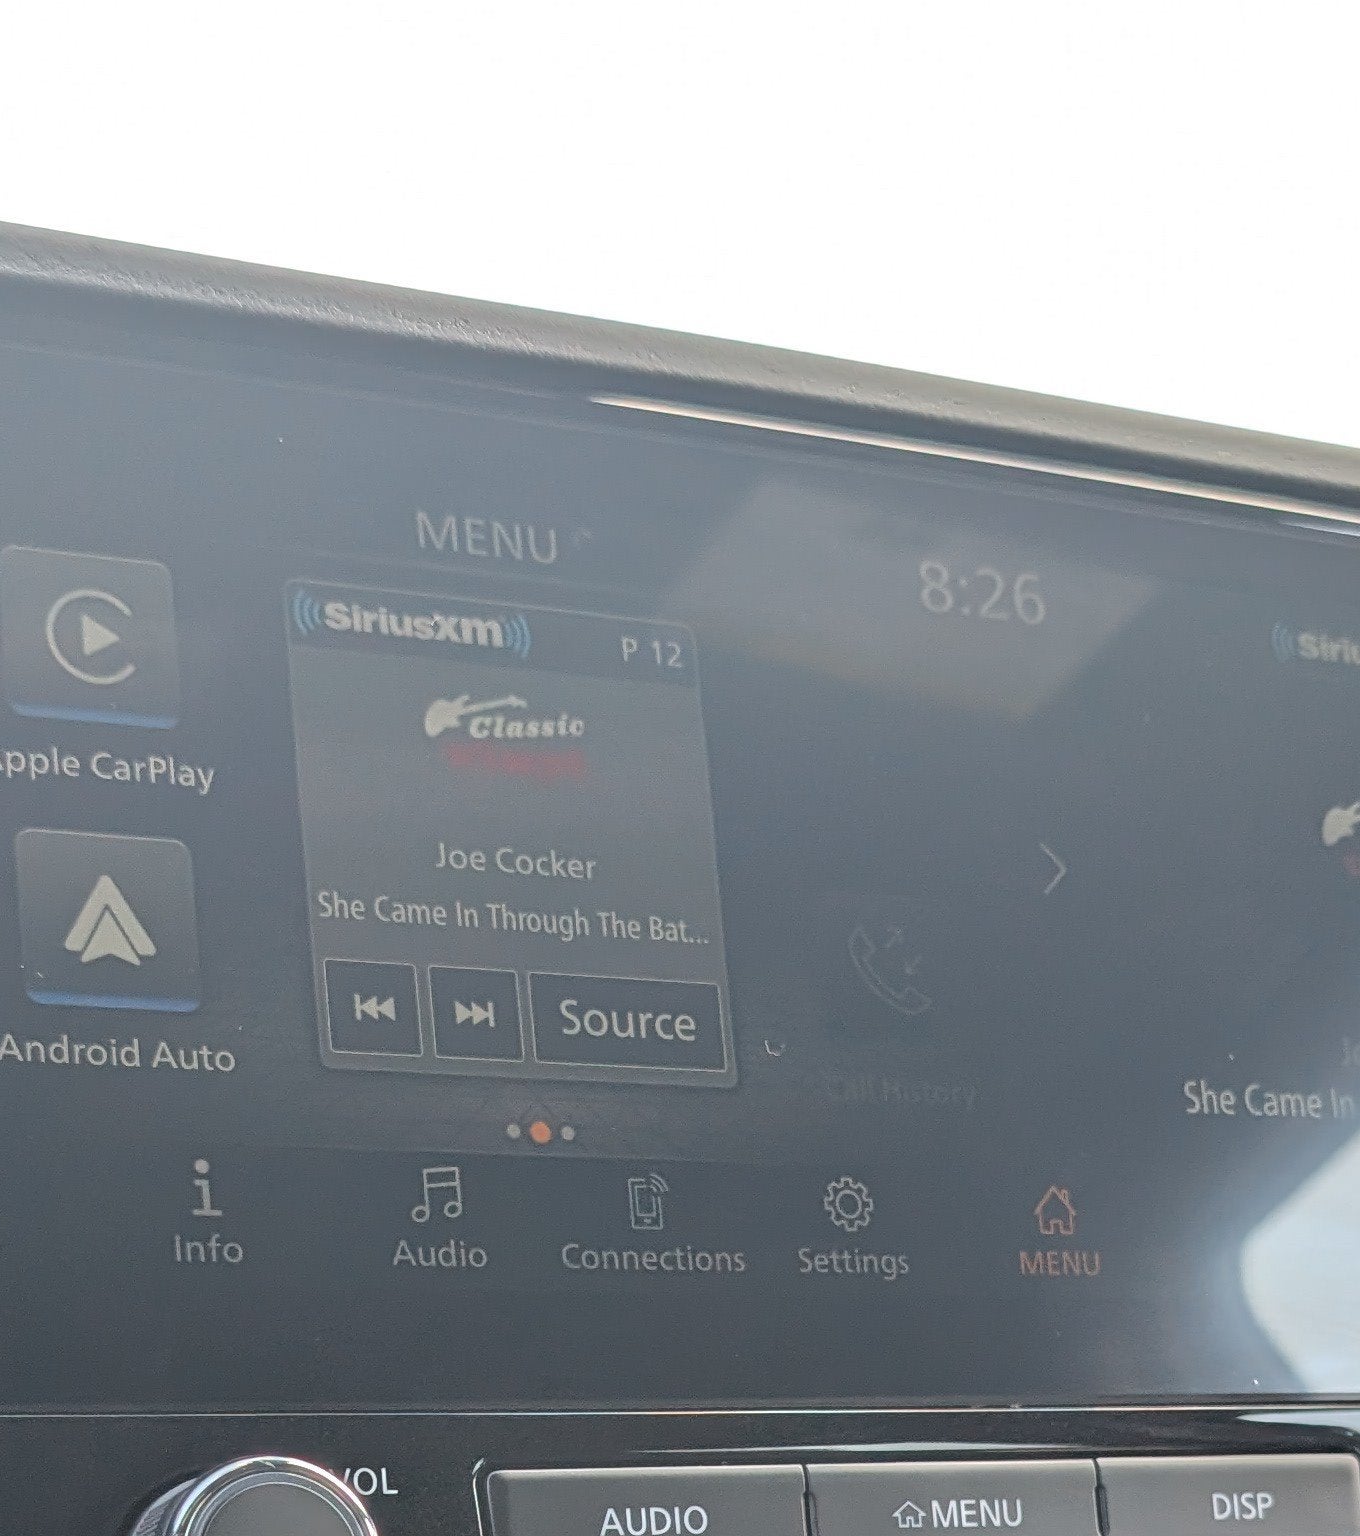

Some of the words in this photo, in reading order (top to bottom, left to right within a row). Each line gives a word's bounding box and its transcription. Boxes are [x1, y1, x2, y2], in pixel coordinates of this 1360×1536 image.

[415, 511, 558, 564] MENU
[918, 559, 1047, 626] 8:26
[621, 636, 637, 661] P
[653, 640, 682, 668] 12
[468, 714, 585, 739] Classic
[90, 751, 215, 795] CarPlay
[436, 842, 486, 871] Joe
[495, 847, 596, 880] Cocker
[318, 891, 366, 921] She
[374, 896, 447, 927] Came
[455, 901, 479, 929] In
[486, 902, 590, 942] Through
[597, 911, 641, 938] The
[560, 999, 697, 1042] Source
[151, 1041, 237, 1072] Auto
[1184, 1079, 1235, 1117] She
[1244, 1083, 1323, 1119] Came
[1330, 1086, 1357, 1120] In
[174, 1235, 244, 1263] Info
[392, 1239, 488, 1269] Audio
[561, 1243, 747, 1273] Connections
[798, 1246, 910, 1281] Settings
[1019, 1250, 1102, 1277] MENU
[599, 1504, 709, 1536] AUDIO
[930, 1499, 1024, 1529] MENU
[1211, 1492, 1274, 1522] DISP
